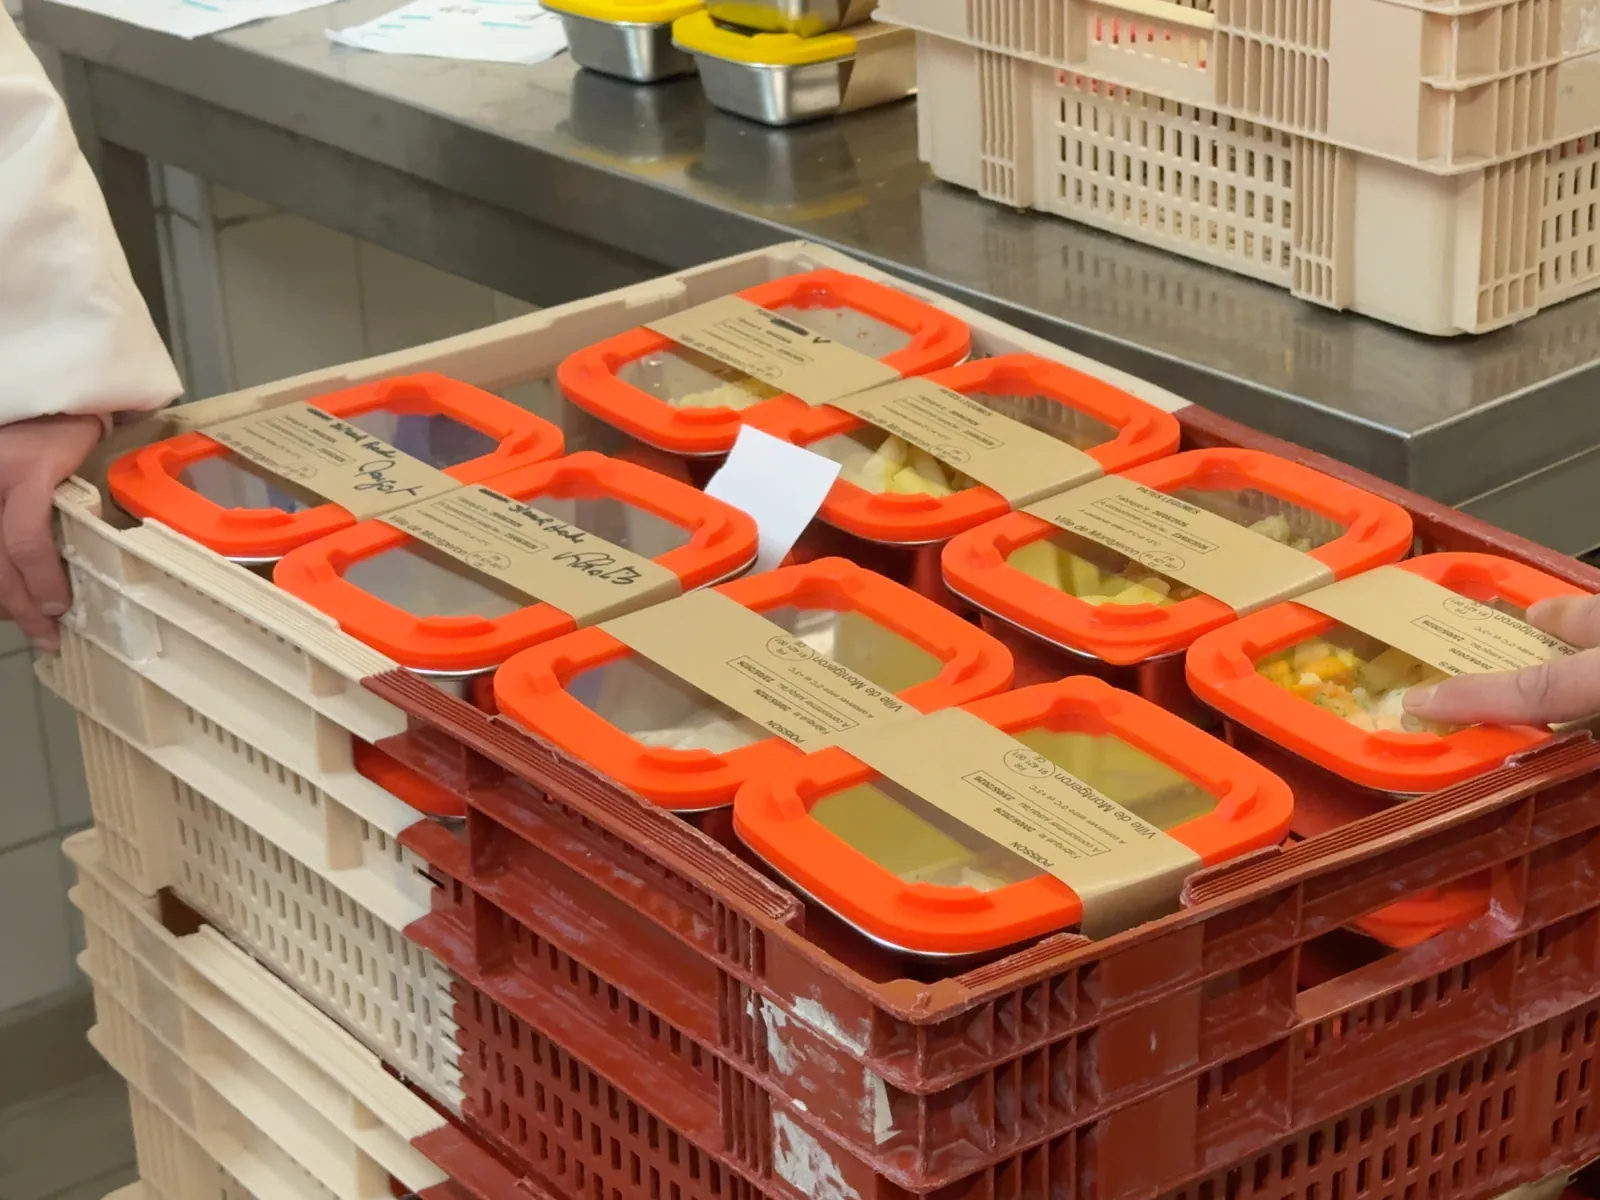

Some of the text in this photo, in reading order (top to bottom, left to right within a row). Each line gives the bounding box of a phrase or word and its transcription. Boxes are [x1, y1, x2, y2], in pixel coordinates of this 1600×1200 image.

[1088, 531, 1140, 555] Montgeron
[1494, 615, 1576, 656] de Montgeron
[813, 657, 903, 712] Ville de Montgeron
[766, 720, 805, 743] POISSON
[1014, 763, 1028, 772] FR
[1054, 774, 1156, 839] Ville de Montgeron
[1011, 842, 1054, 867] POISSON
